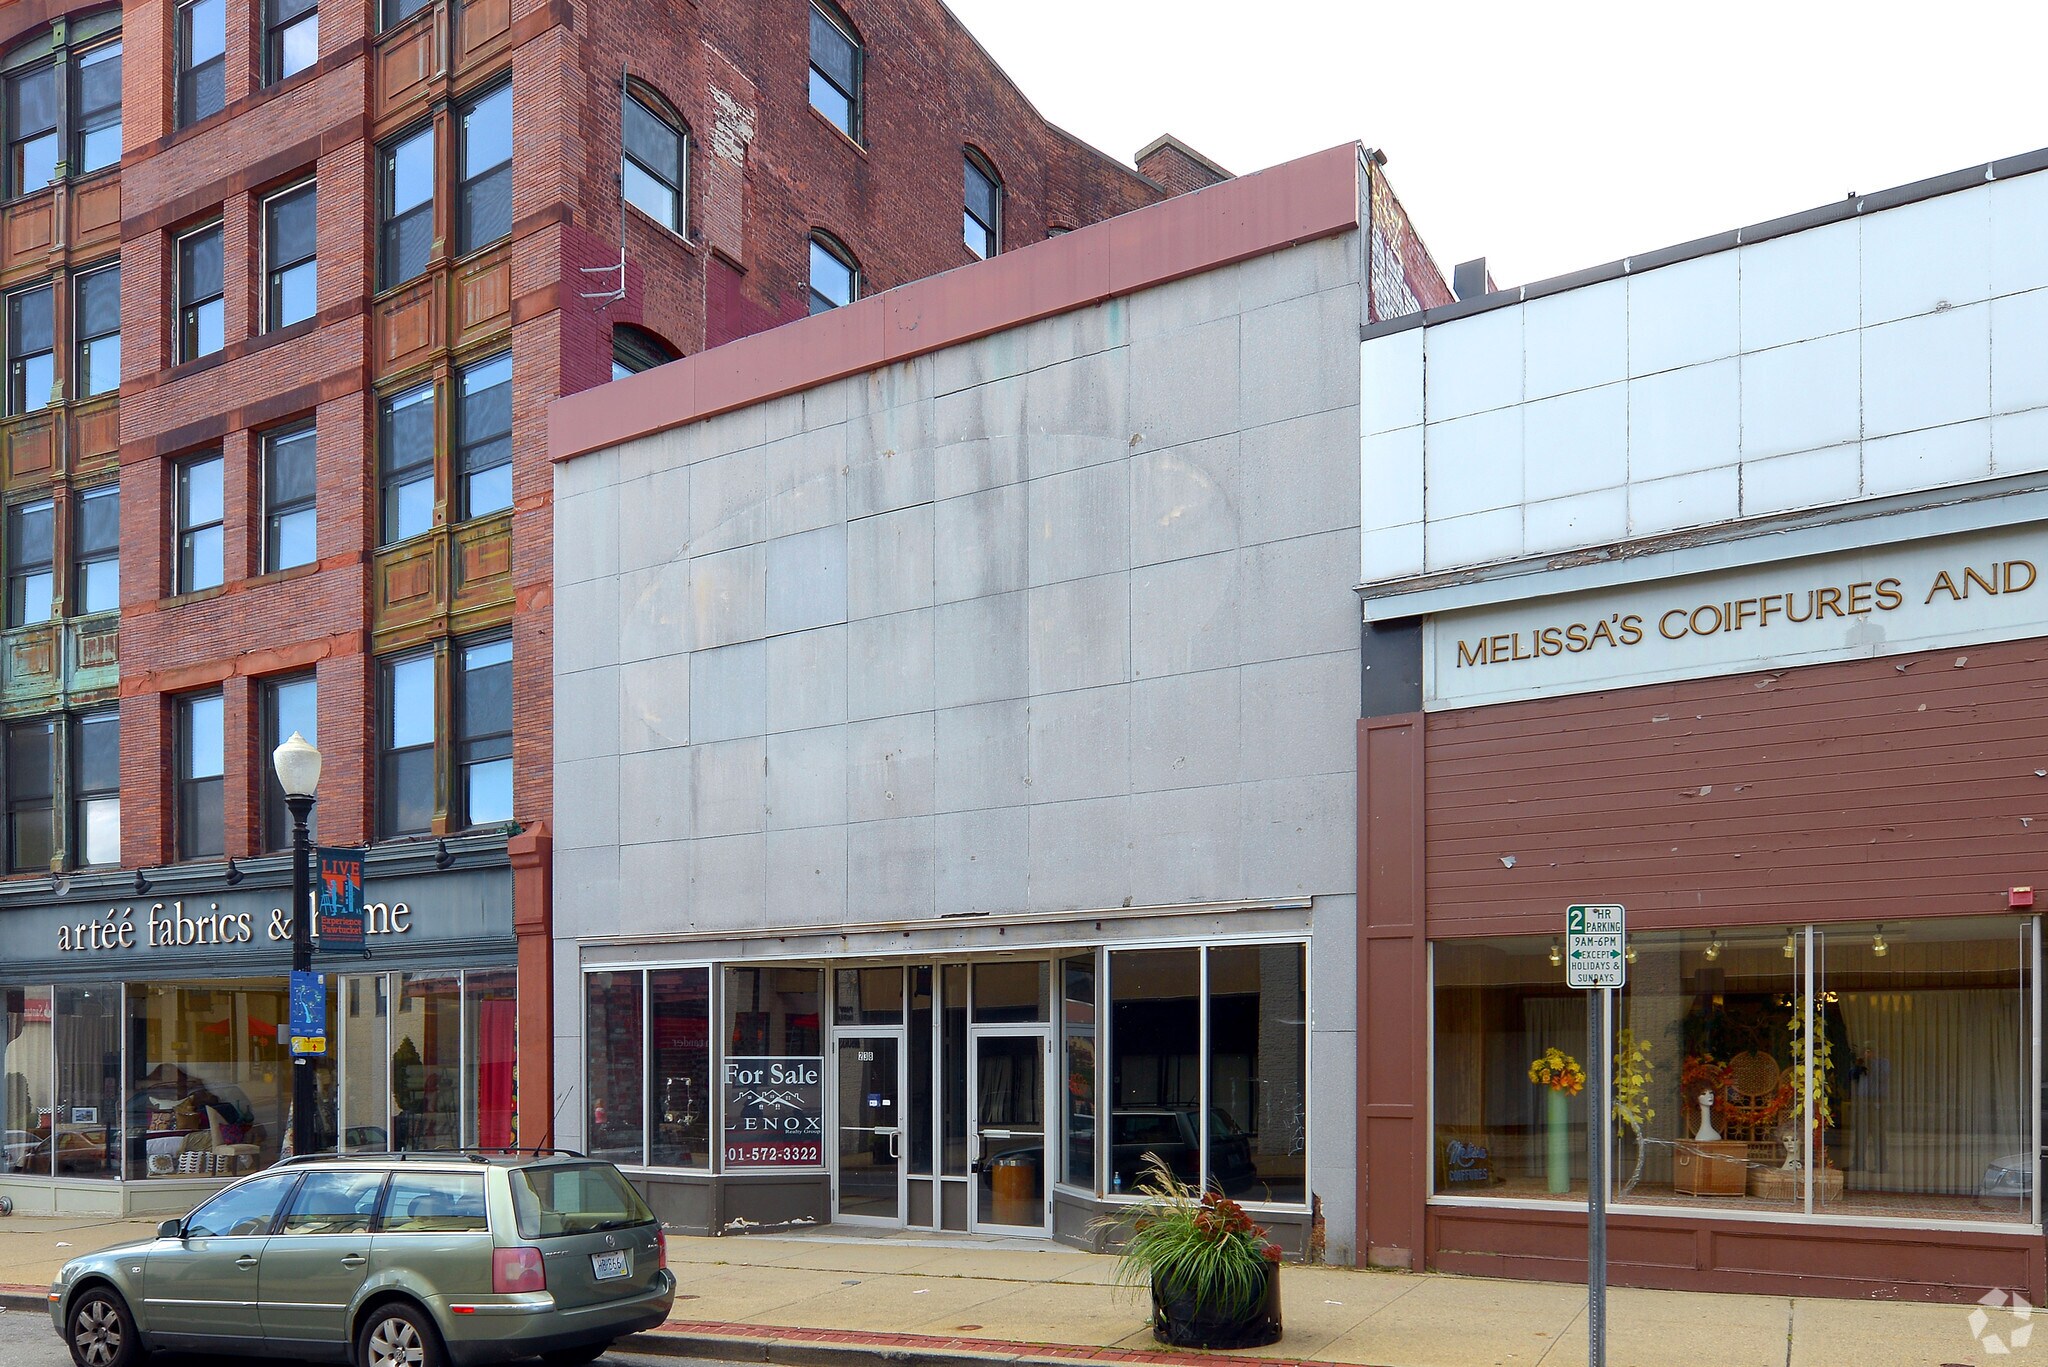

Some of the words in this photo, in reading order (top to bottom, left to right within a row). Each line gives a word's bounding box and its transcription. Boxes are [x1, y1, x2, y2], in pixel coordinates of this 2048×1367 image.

[1456, 613, 1643, 668] MELISSA'S
[1658, 577, 1903, 640] COIFFURES
[1924, 560, 2037, 605] AND
[322, 859, 360, 876] LIVE
[321, 915, 362, 926] Experience
[1570, 910, 1583, 931] 2
[1597, 909, 1611, 919] HR
[57, 907, 136, 951] artéé
[147, 901, 254, 947] fabrics
[267, 908, 293, 941] &
[321, 924, 362, 935] Pawtucket
[1586, 922, 1621, 932] PARKING
[1575, 937, 1616, 947] 9AM-6PM
[1582, 950, 1610, 959] EXCEPT
[1571, 962, 1611, 970] HOLIDAYS
[1613, 962, 1620, 970] &
[1578, 973, 1614, 983] SUNDAYS
[724, 1063, 764, 1085] For
[770, 1063, 818, 1085] Sale
